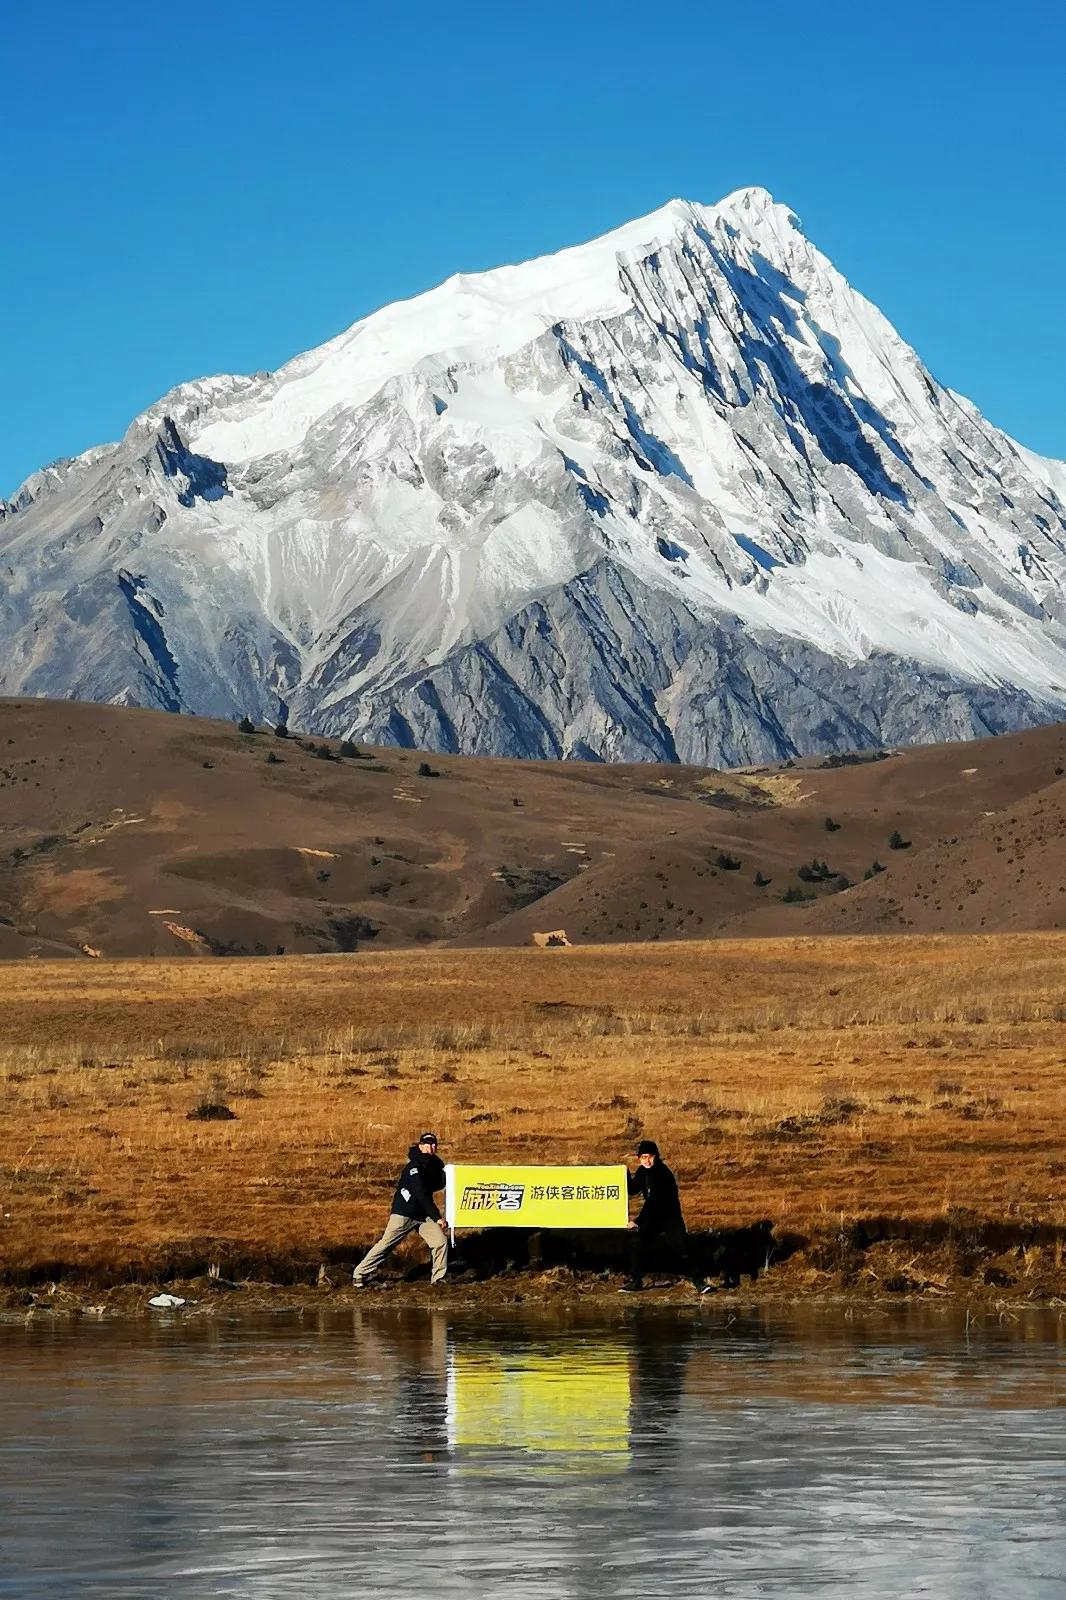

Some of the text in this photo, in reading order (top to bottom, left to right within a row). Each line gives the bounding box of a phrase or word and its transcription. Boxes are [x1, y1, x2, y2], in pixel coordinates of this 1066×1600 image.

[530, 1185, 620, 1200] 游侠客旅游网
